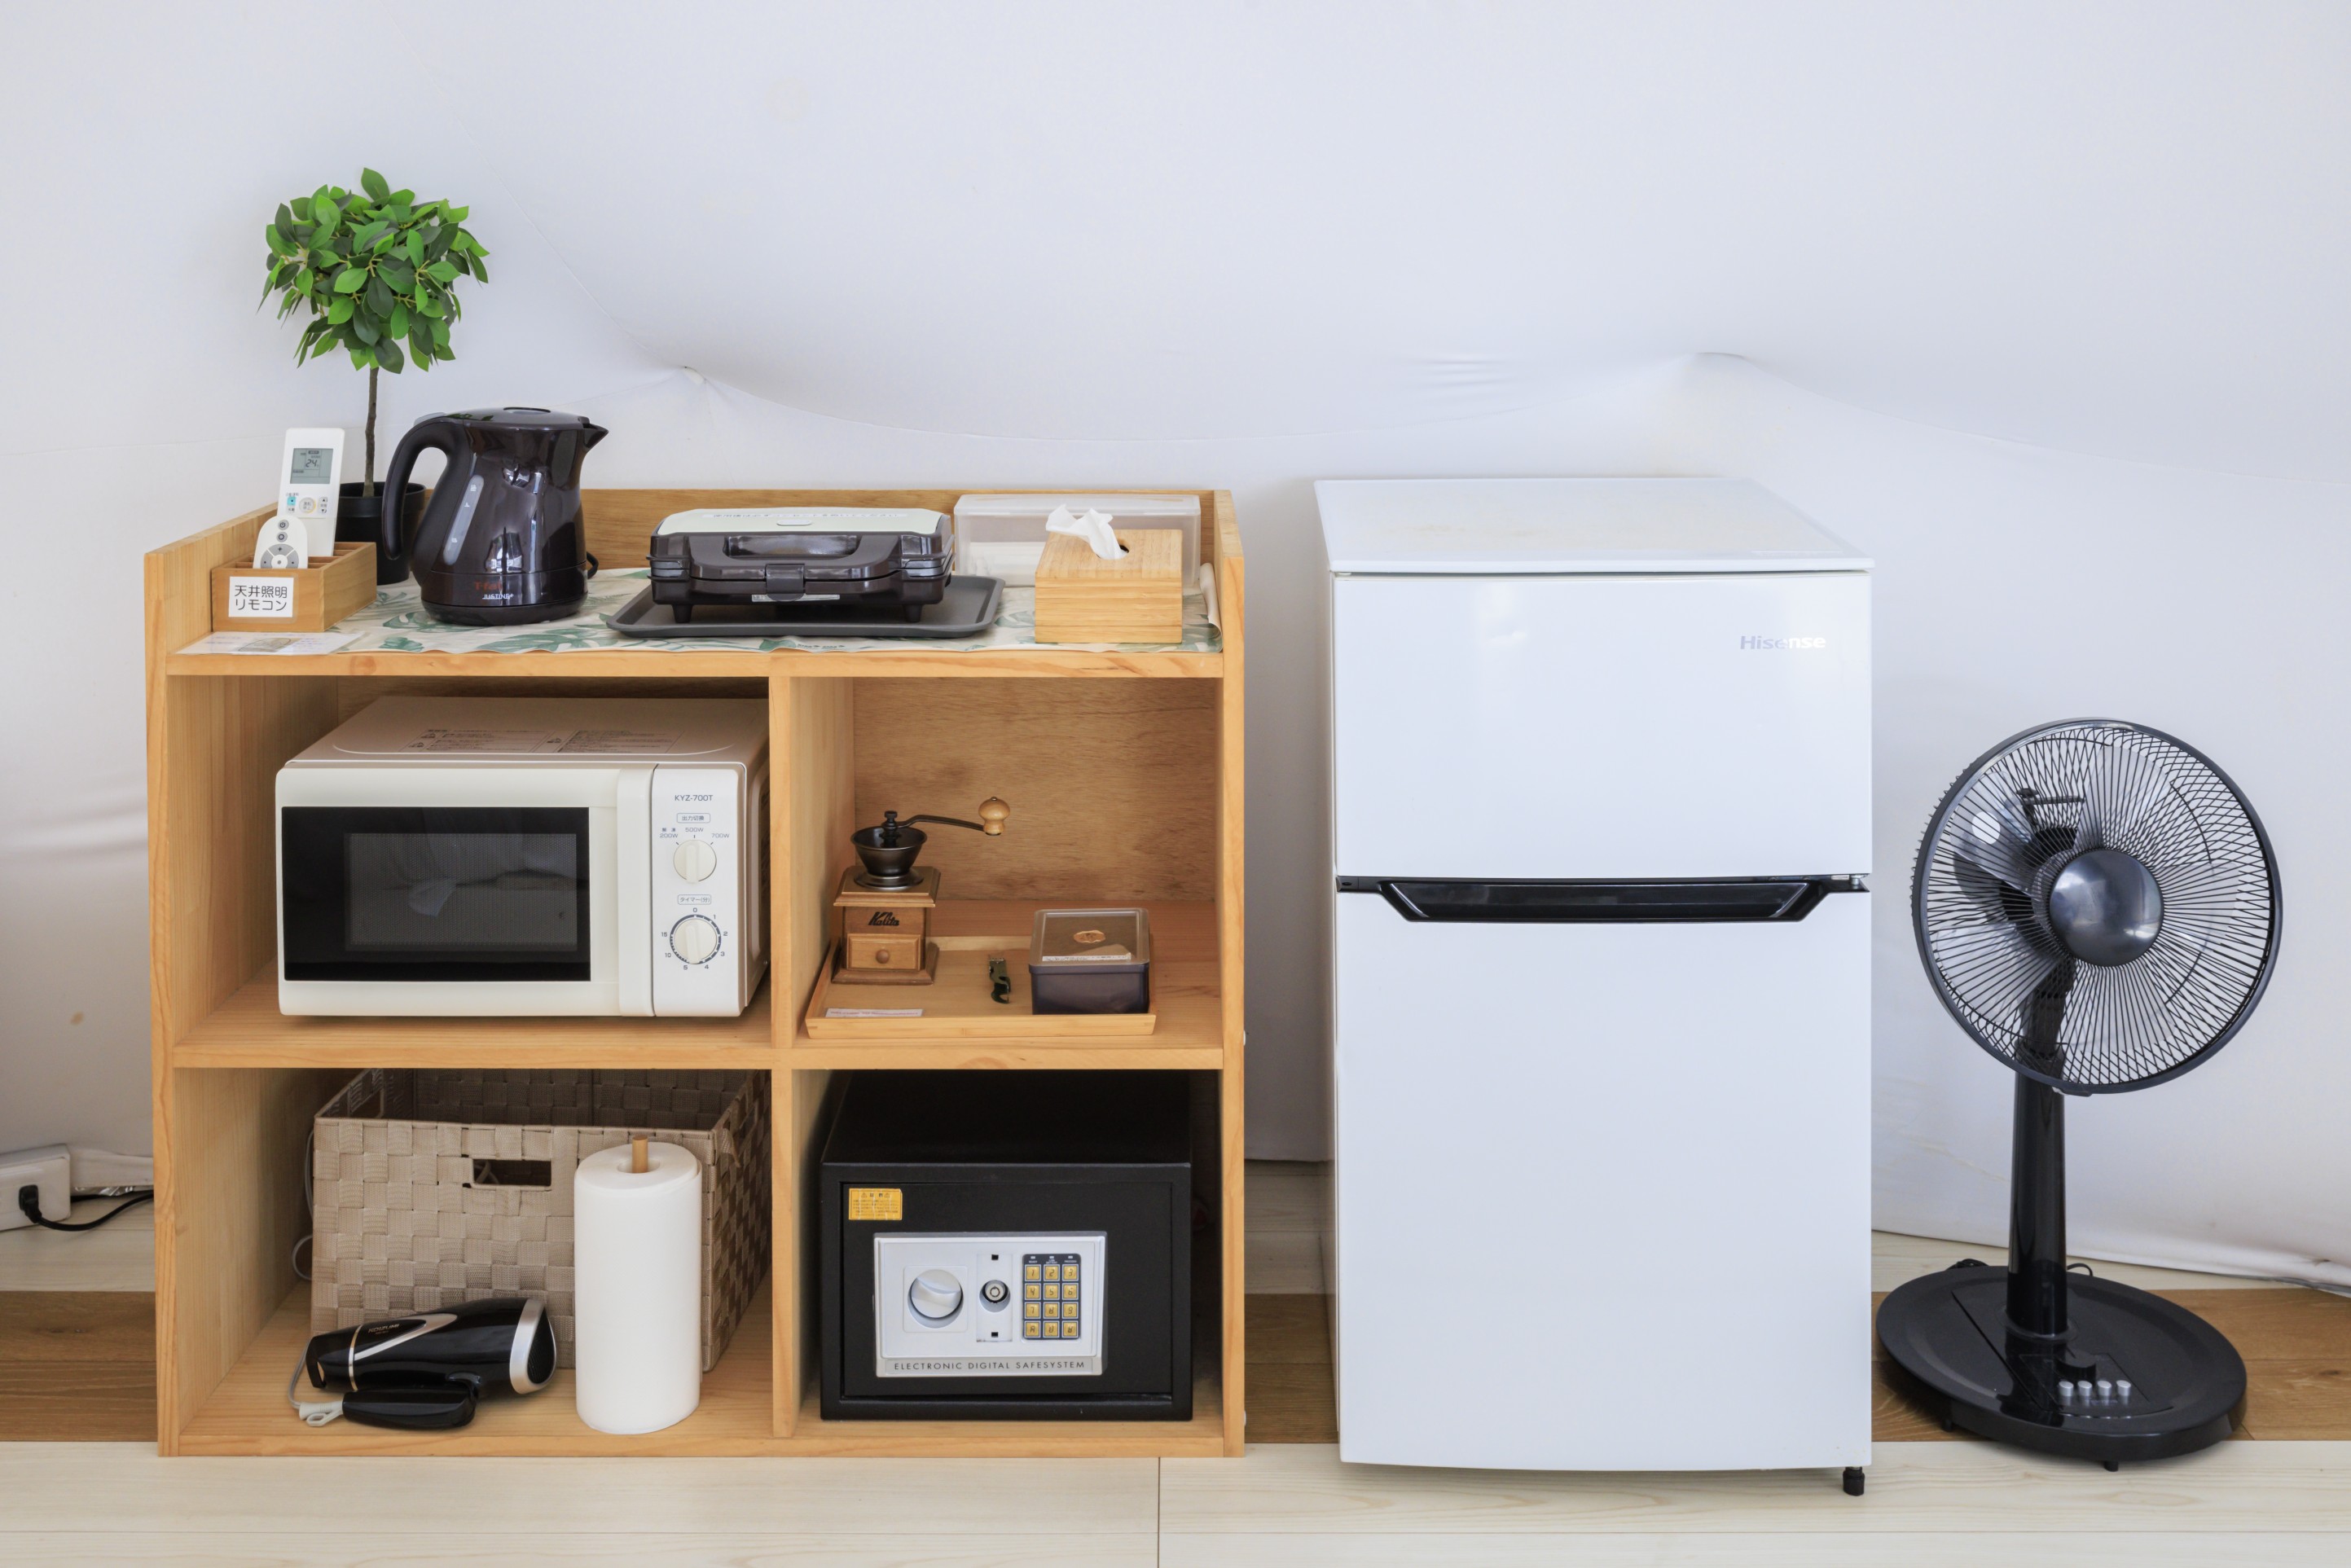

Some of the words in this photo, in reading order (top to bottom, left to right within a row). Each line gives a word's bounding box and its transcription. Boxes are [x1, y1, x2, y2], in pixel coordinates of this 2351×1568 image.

[305, 459, 318, 468] 24
[235, 585, 288, 599] 天井照明
[235, 599, 287, 612] リモコン
[1740, 635, 1826, 650] Hisense
[868, 911, 900, 926] Kalita
